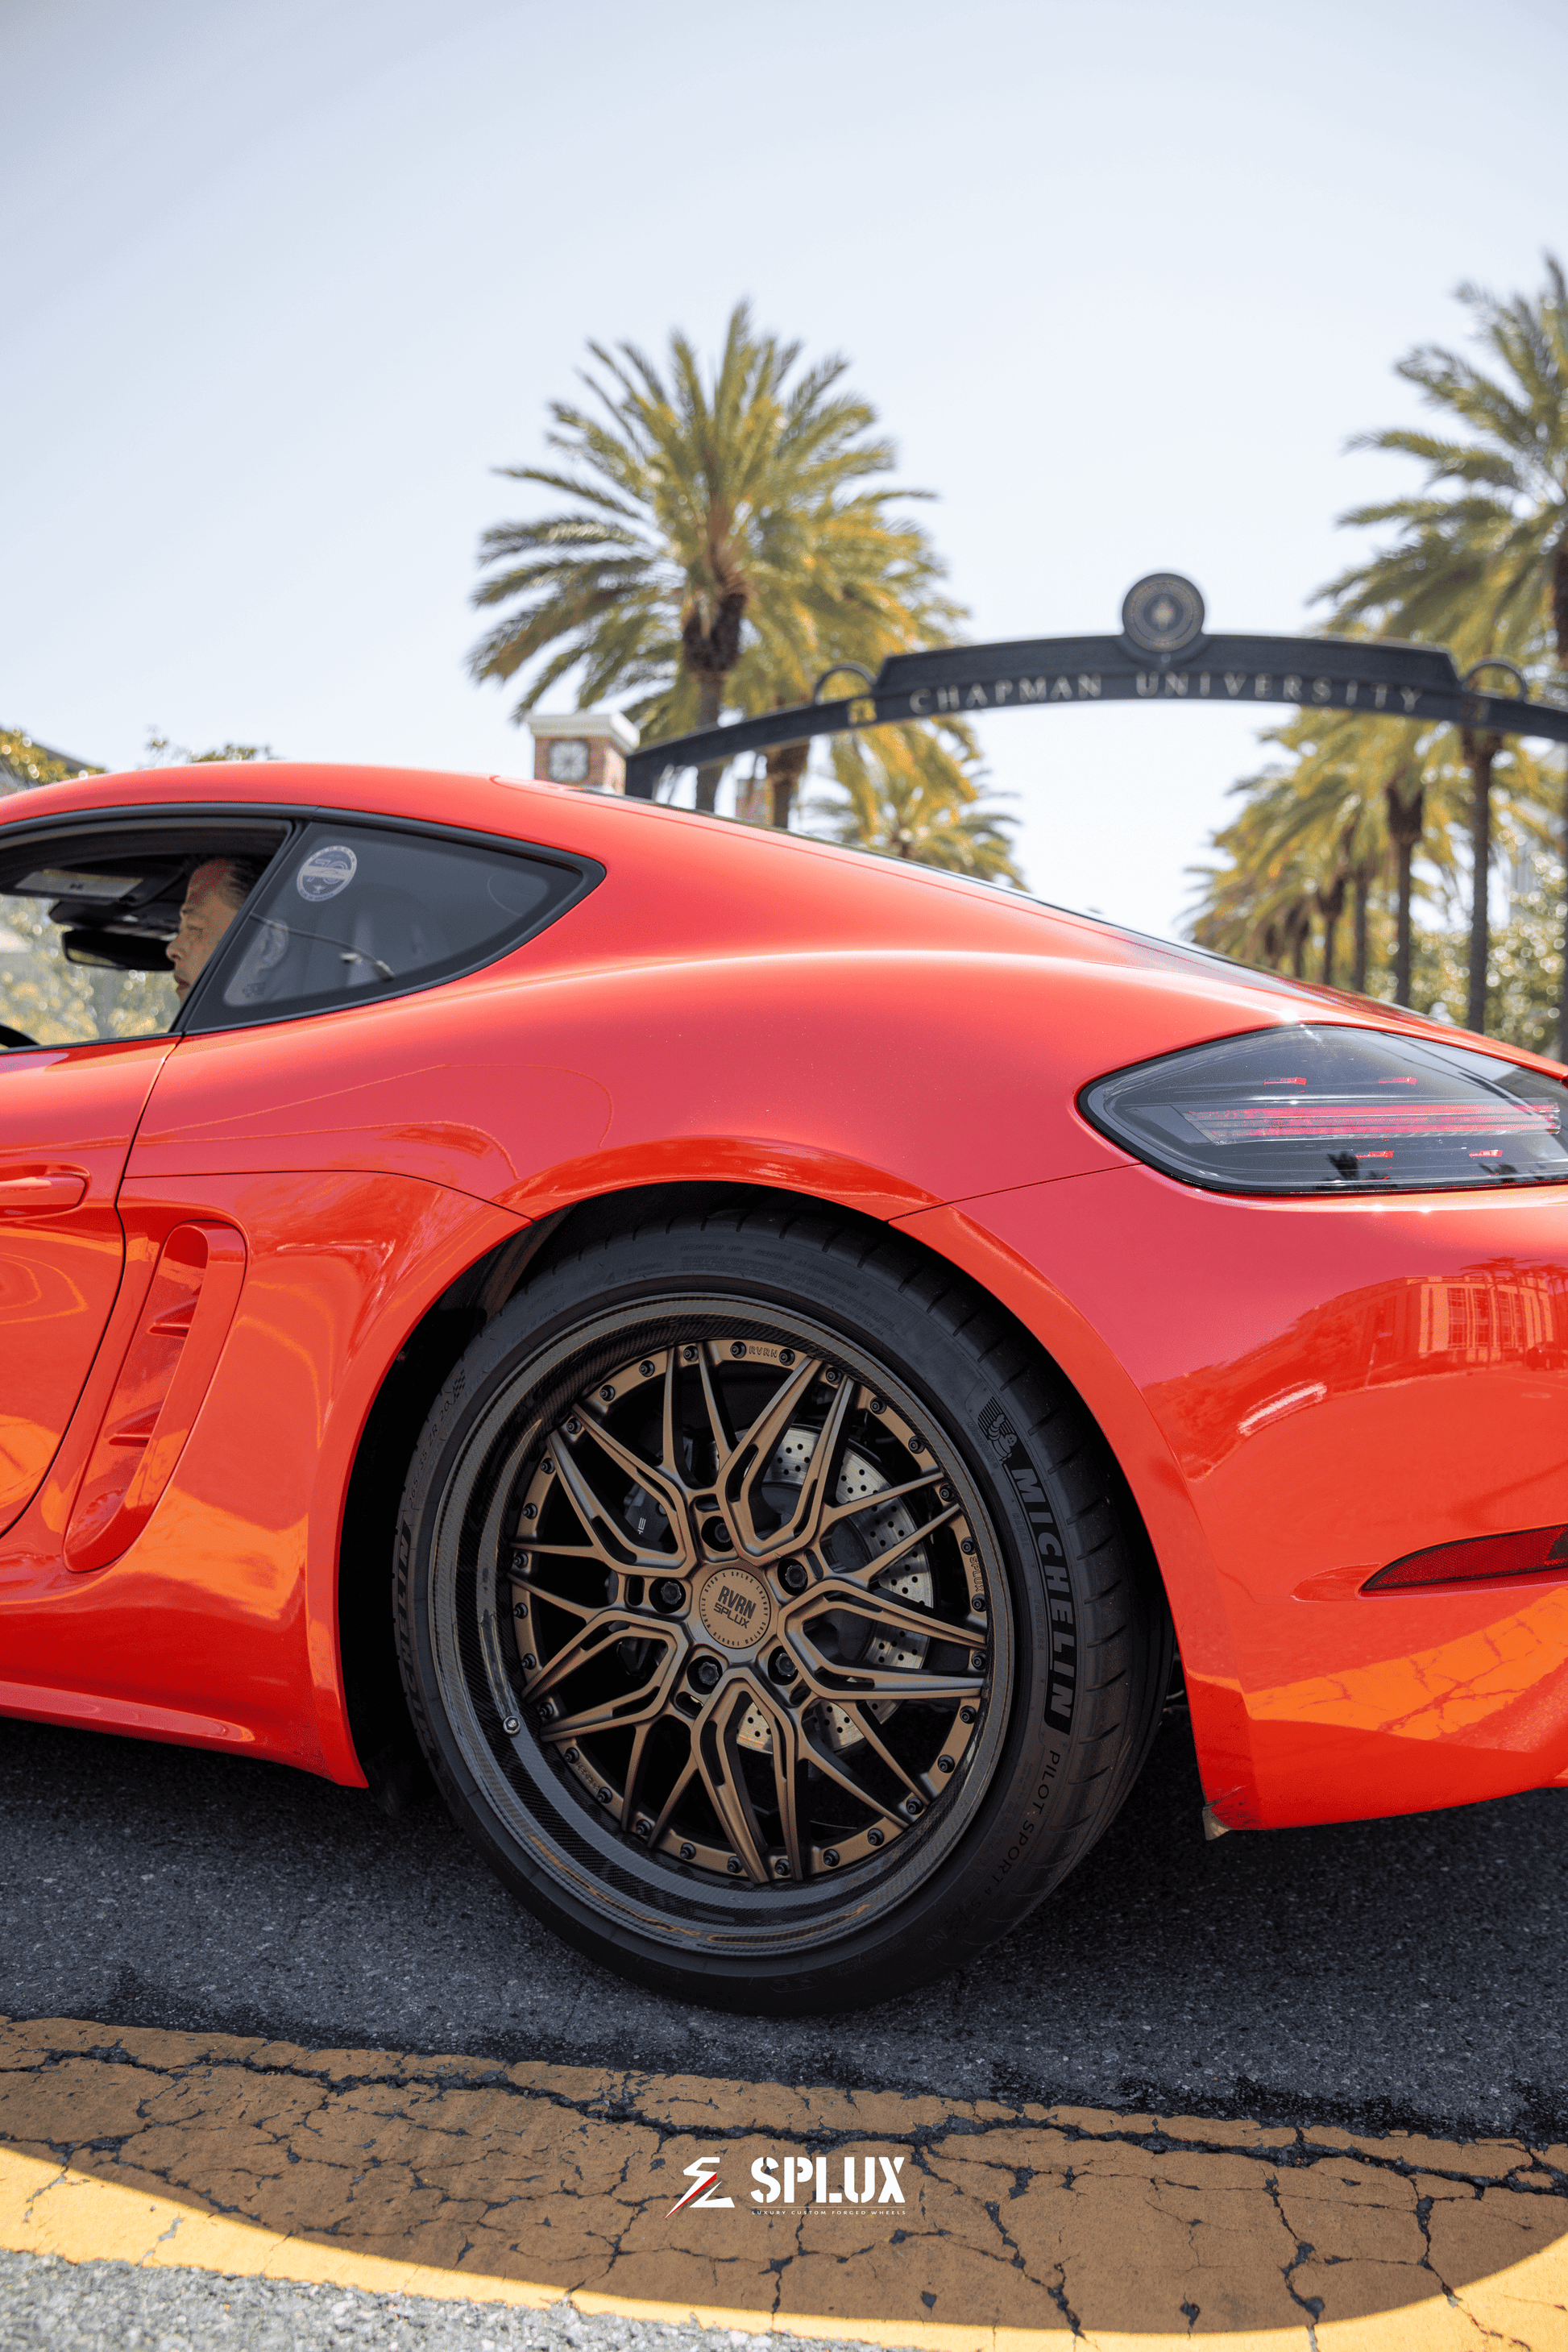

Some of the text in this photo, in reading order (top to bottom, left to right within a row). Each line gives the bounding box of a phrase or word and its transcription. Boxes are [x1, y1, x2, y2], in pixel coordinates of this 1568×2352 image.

[909, 670, 1424, 715] CHAPMAN UNIVERSITY
[749, 1345, 778, 1359] RVRN
[427, 1423, 438, 1447] ZR
[1011, 1512, 1030, 1549] RADIAL
[969, 1555, 984, 1593] SPLUX
[1010, 1468, 1075, 1718] MICHELIN
[713, 1602, 750, 1629] SPLUX
[717, 1585, 757, 1620] RVRN
[398, 1533, 434, 1750] MICHELIN
[1032, 1749, 1061, 1815] PILOT
[992, 1819, 1035, 1885] SPORT
